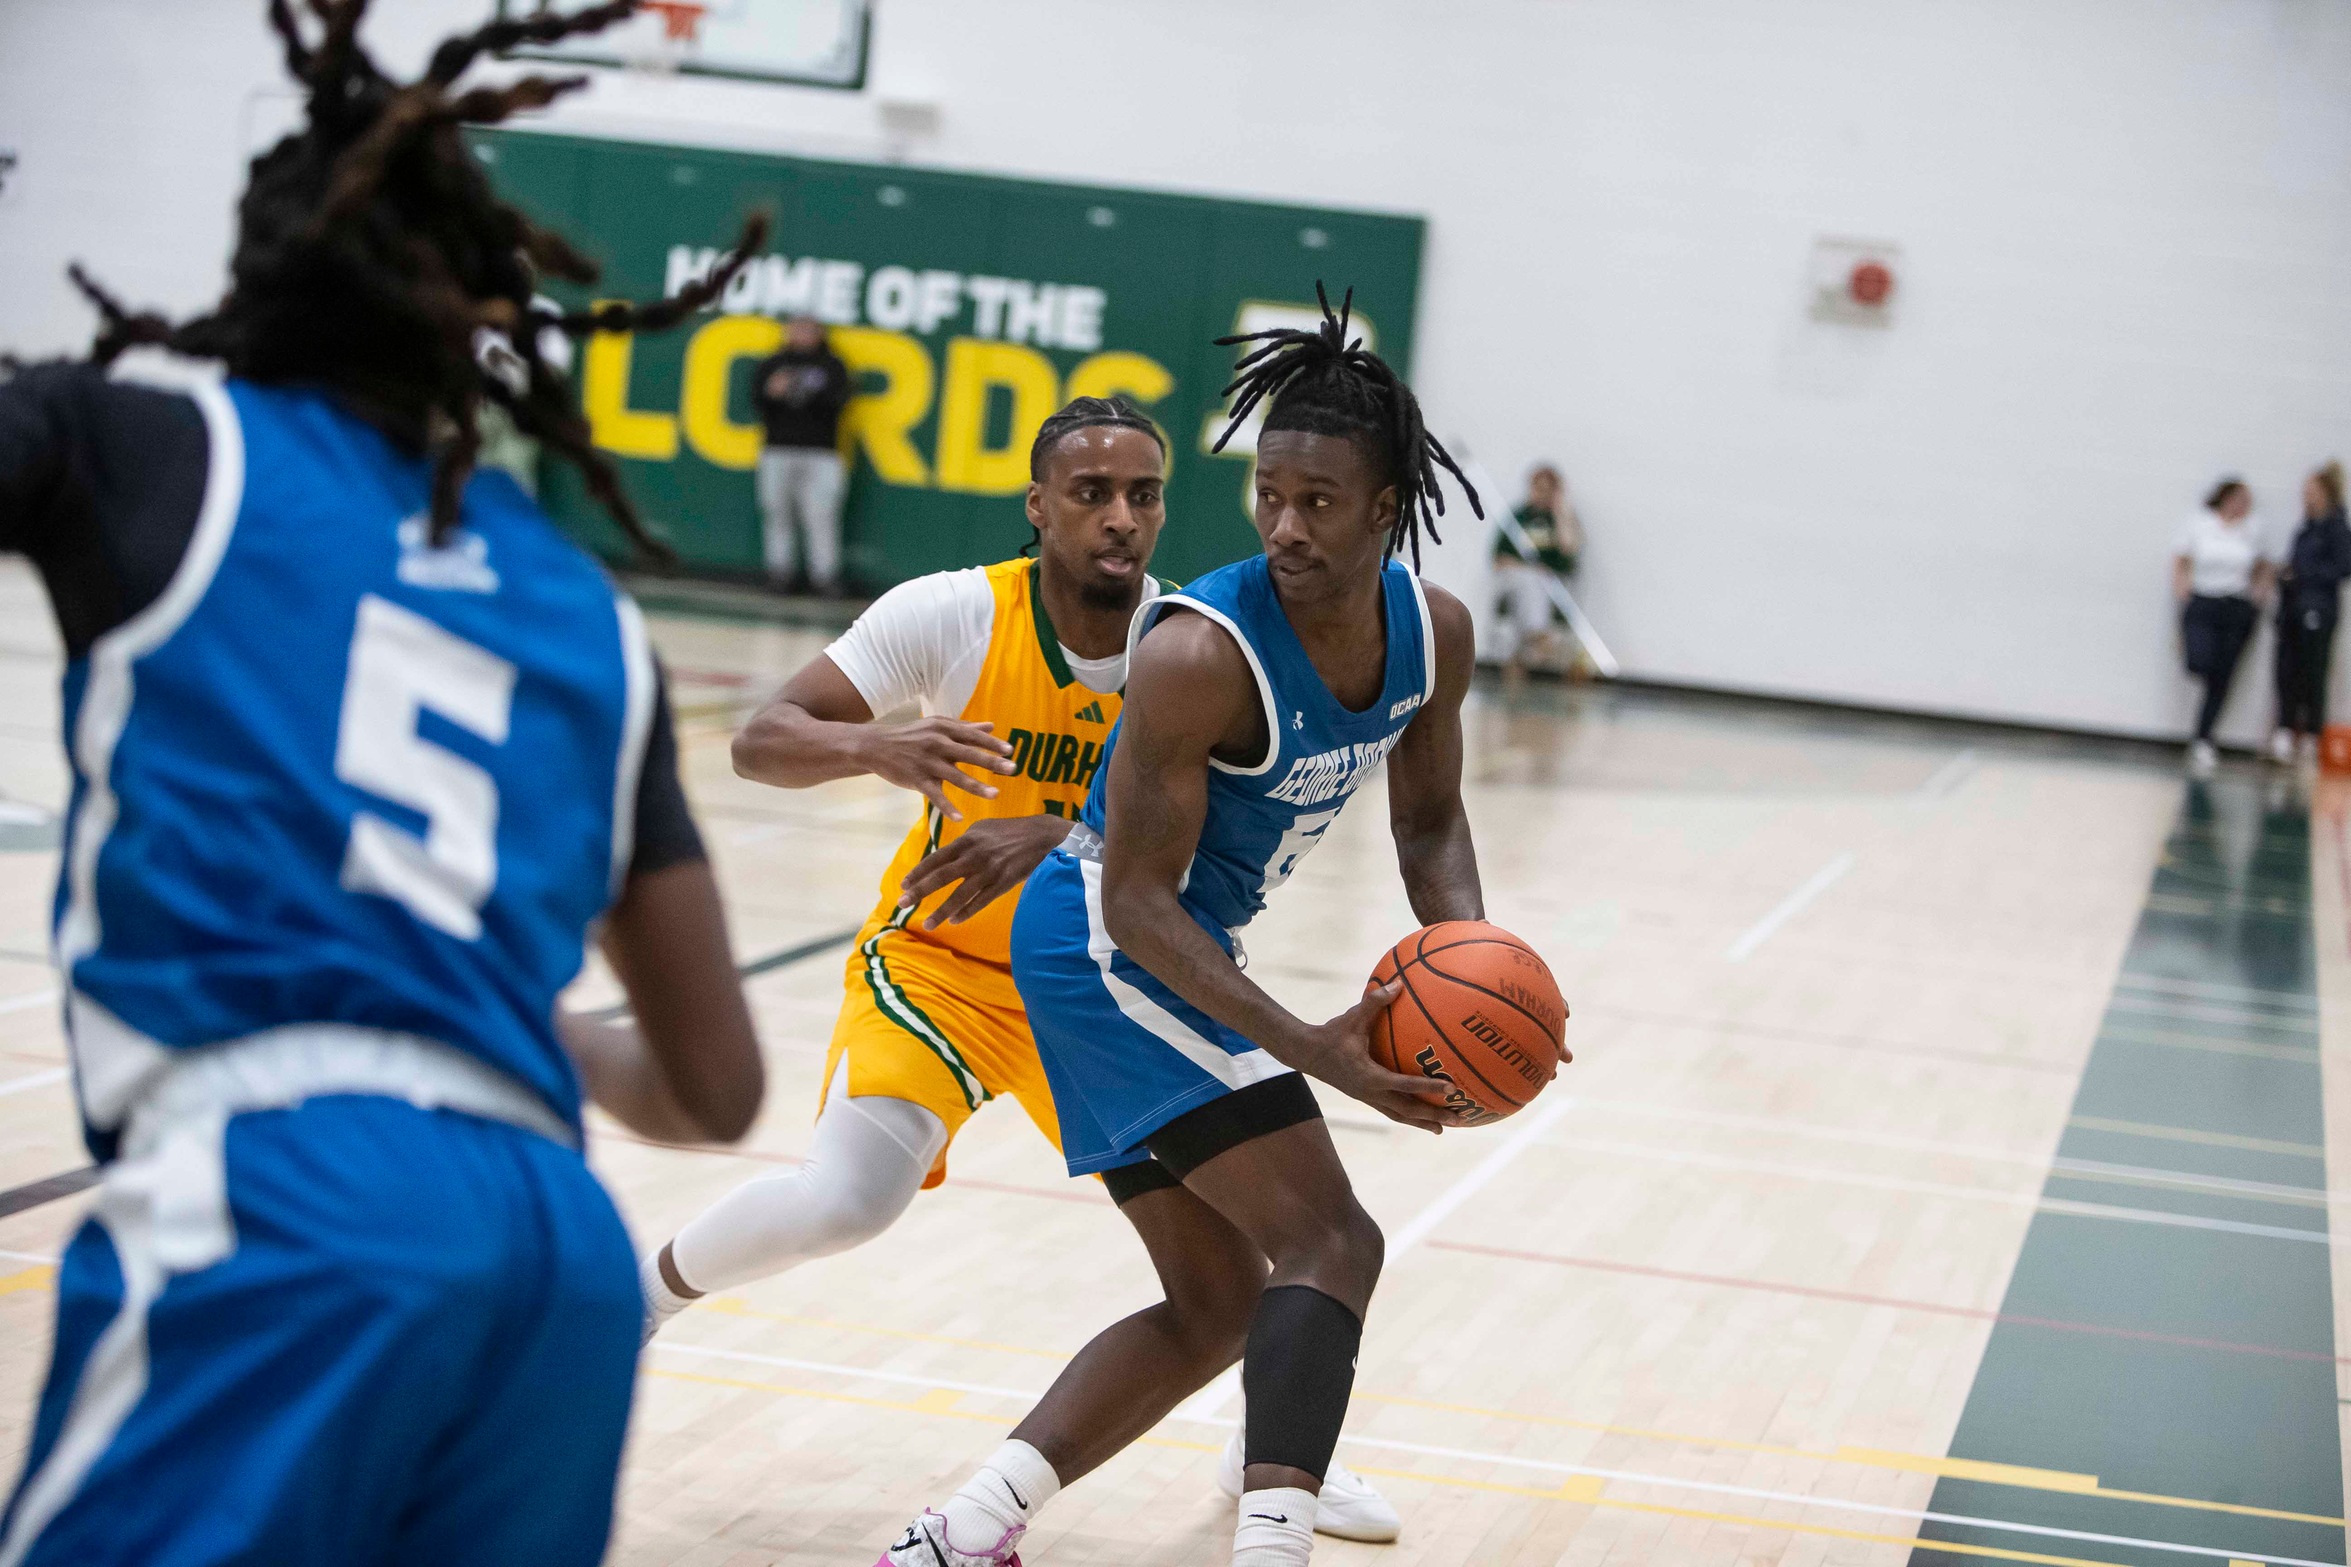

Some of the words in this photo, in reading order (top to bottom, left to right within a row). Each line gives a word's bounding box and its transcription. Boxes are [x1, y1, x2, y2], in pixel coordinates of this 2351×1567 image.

[664, 245, 864, 326] HOME
[867, 264, 963, 336] OF
[968, 273, 1106, 351] THE
[1389, 693, 1421, 721] OCAA
[336, 593, 516, 941] 5
[993, 728, 1104, 790] DURH
[1264, 746, 1350, 806] GEORGE
[1415, 1044, 1506, 1126] ilsn
